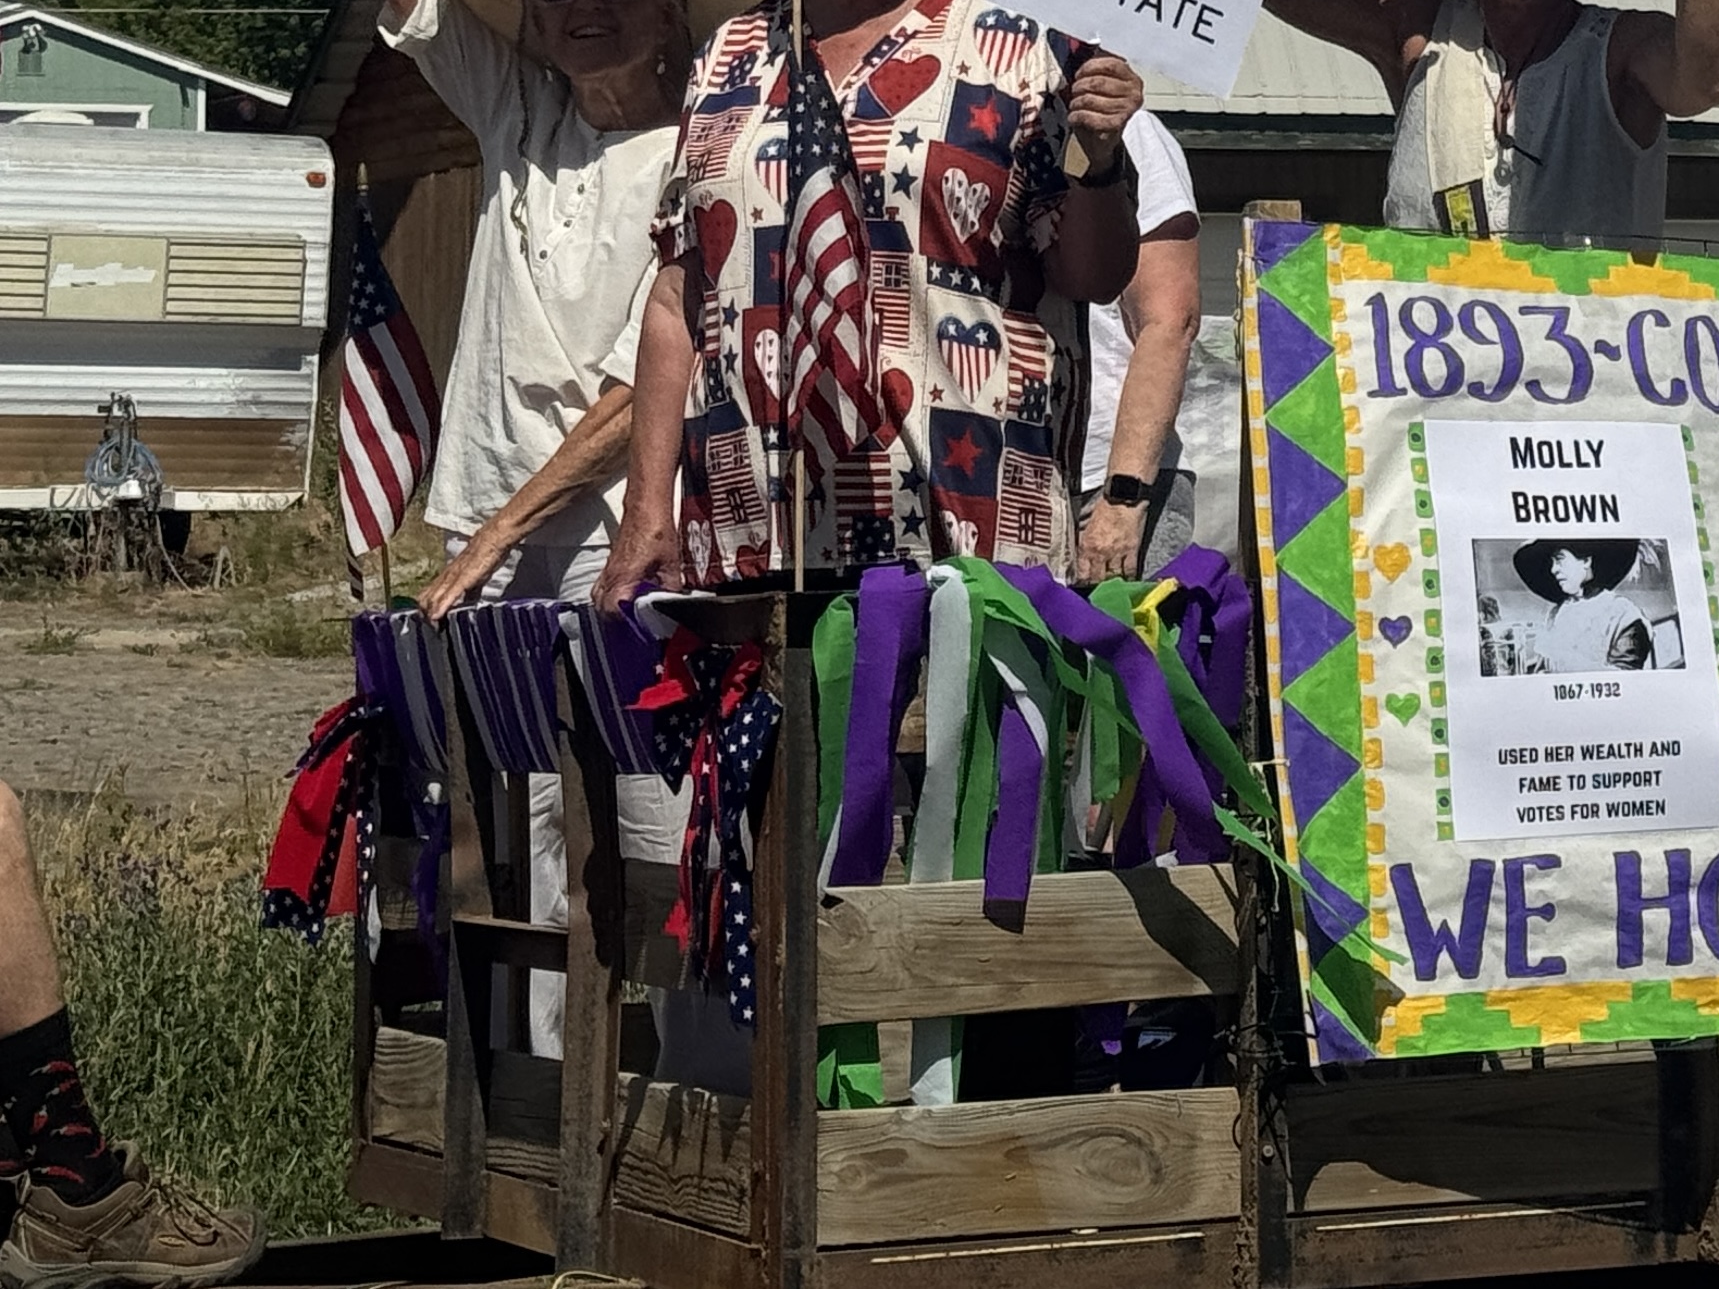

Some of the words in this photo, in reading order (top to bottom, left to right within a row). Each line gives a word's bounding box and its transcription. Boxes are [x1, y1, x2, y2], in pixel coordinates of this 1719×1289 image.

[1509, 436, 1605, 469] MOLLY
[1511, 491, 1620, 523] BROWN
[1499, 747, 1538, 765] USED
[1544, 745, 1574, 763] HER
[1581, 741, 1644, 762] WEALTH
[1649, 740, 1681, 757] AND
[1519, 776, 1561, 794] FAME
[1567, 774, 1586, 790] TO
[1592, 769, 1663, 790] SUPPORT
[1516, 805, 1565, 824] VOTES
[1571, 802, 1600, 820] FOR
[1606, 799, 1666, 818] WOMEN
[1390, 854, 1567, 982] WE
